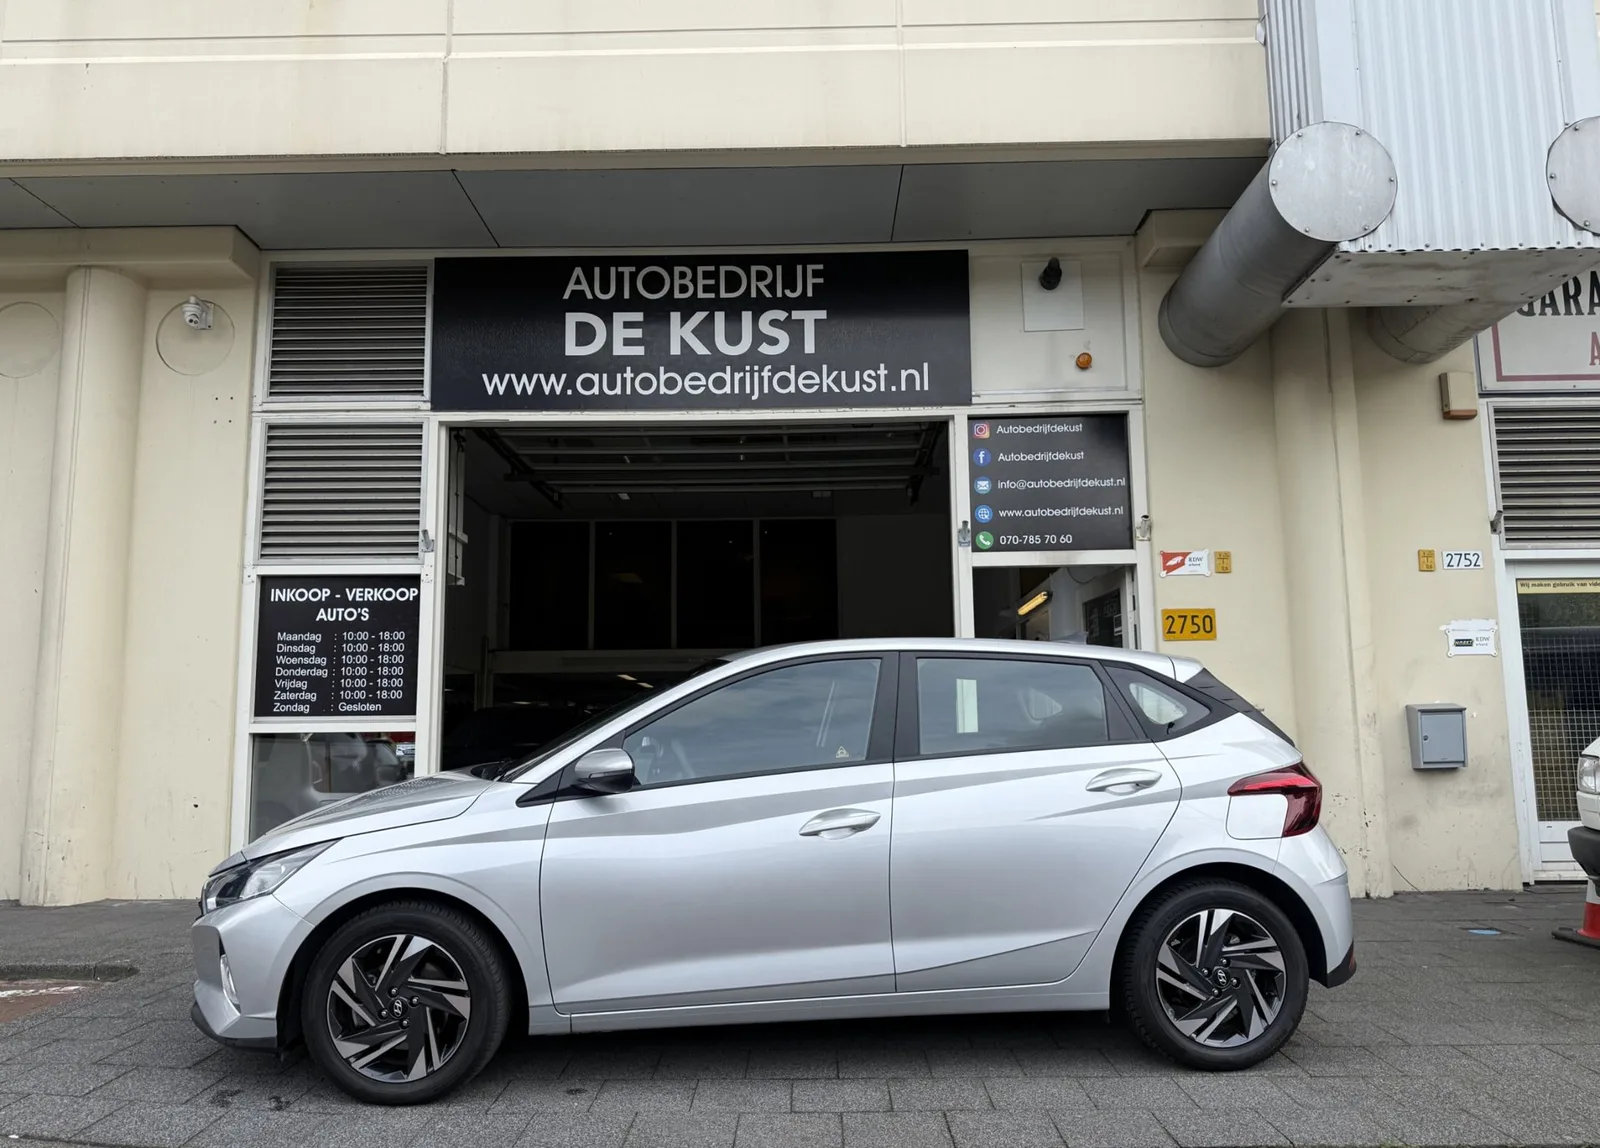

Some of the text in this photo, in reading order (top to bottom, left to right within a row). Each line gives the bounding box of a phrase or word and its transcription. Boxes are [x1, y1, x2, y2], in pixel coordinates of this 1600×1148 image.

[562, 264, 824, 299] AUTOBEDRIJF
[564, 309, 827, 356] DE KUST
[482, 362, 930, 400] www.autobedrijfdekust.nl
[996, 423, 1083, 434] Autobedrijfdekust
[998, 451, 1084, 462] Autobedrijfdekust
[998, 477, 1125, 490] info@autobedrijfdekust.nl
[999, 506, 1123, 517] www.autobedrijfdekust.nl
[1000, 534, 1072, 545] 070-785 70 60
[1446, 552, 1481, 568] 2752
[270, 588, 330, 602] INKOOP
[345, 588, 418, 601] VERKOOP
[316, 608, 370, 621] AUTO'S
[1165, 615, 1213, 634] 2750
[277, 632, 322, 643] Maandag
[342, 632, 368, 641] 10:00
[379, 631, 405, 641] 18:00
[276, 644, 316, 654] Dinsdag
[342, 643, 368, 652] 10:00
[378, 643, 405, 652] 18:00
[276, 655, 327, 666] Woensdag
[341, 655, 367, 664] 10:00
[378, 655, 404, 664] 18:00
[275, 667, 328, 678] Donderdag
[340, 667, 367, 676] 10:00
[377, 666, 403, 675] 18:00
[275, 679, 308, 690] Vrijdag
[340, 679, 366, 688] 10:00
[377, 678, 403, 687] 18:00
[274, 691, 317, 702] Zaterdag
[339, 691, 366, 700] 10:00
[376, 690, 403, 699] 18:00
[273, 702, 310, 714] Zondag
[338, 702, 381, 711] Gesloten
